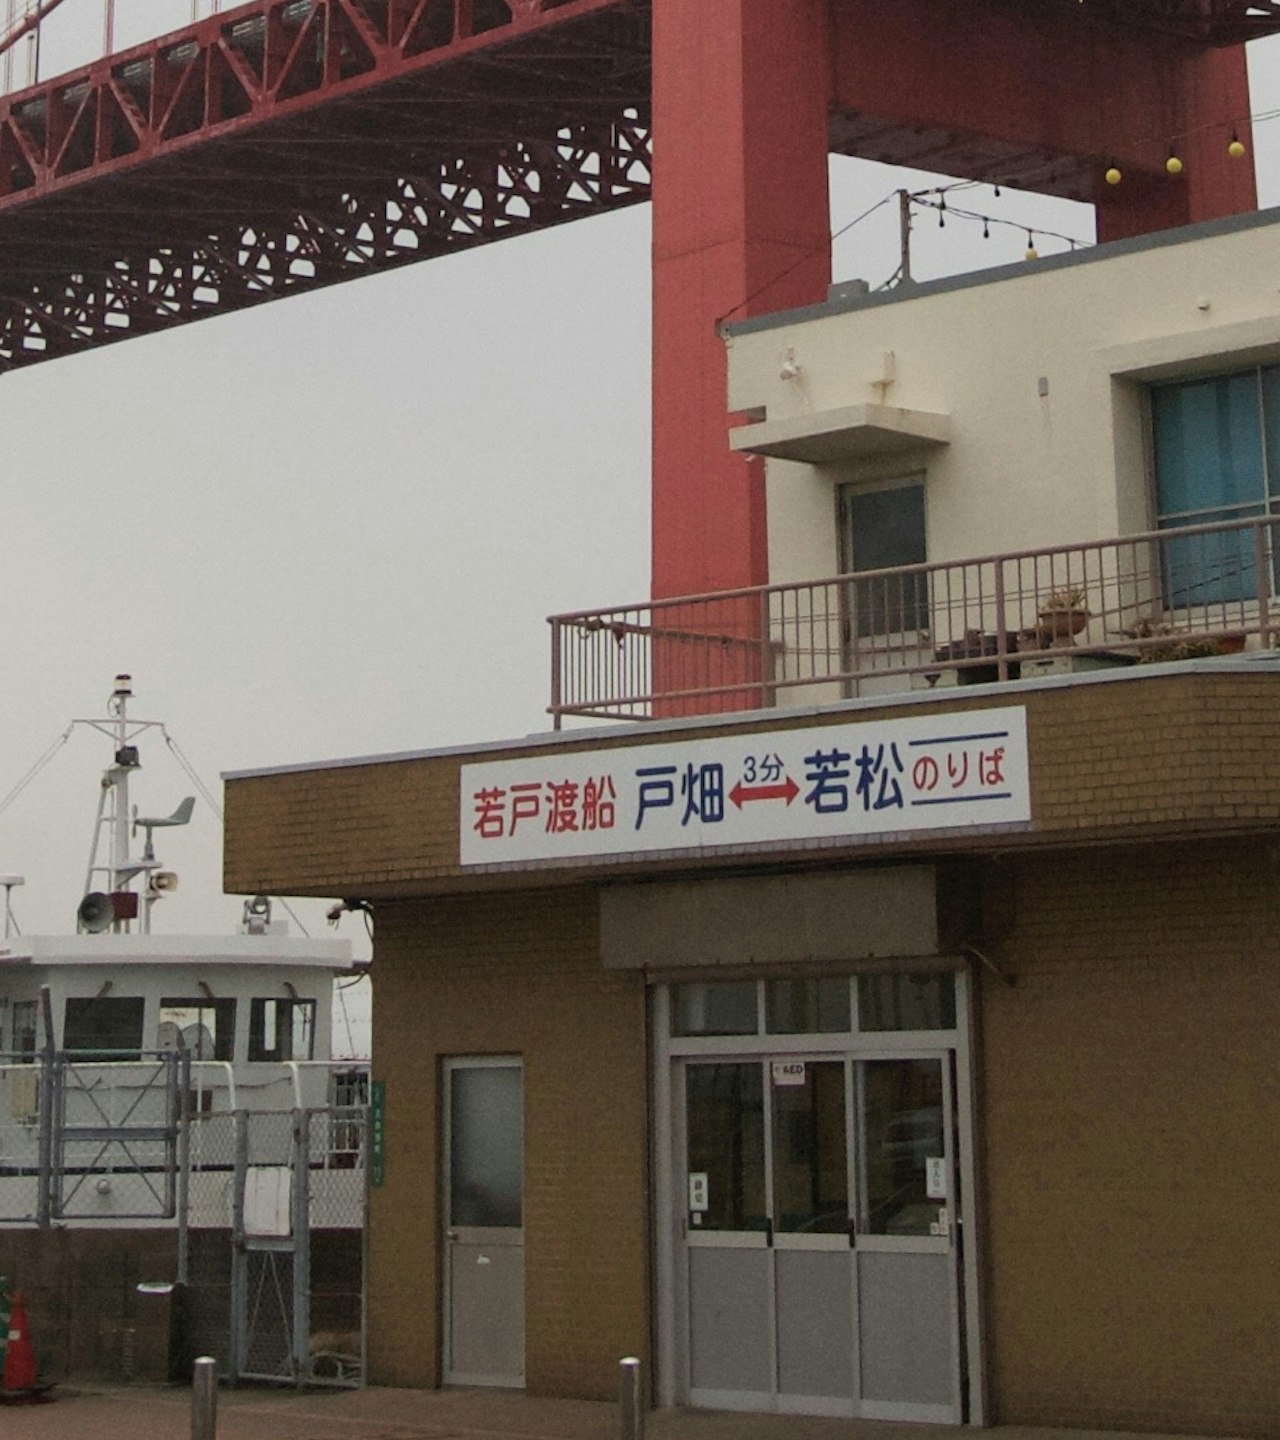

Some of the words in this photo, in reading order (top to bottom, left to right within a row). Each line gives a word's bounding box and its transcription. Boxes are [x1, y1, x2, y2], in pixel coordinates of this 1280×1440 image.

[473, 774, 617, 839] 若戸渡船
[635, 762, 724, 831] 戸畑
[743, 753, 785, 783] 3分
[804, 741, 904, 814] 若松
[913, 745, 1006, 791] のりば
[783, 1064, 803, 1073] AED
